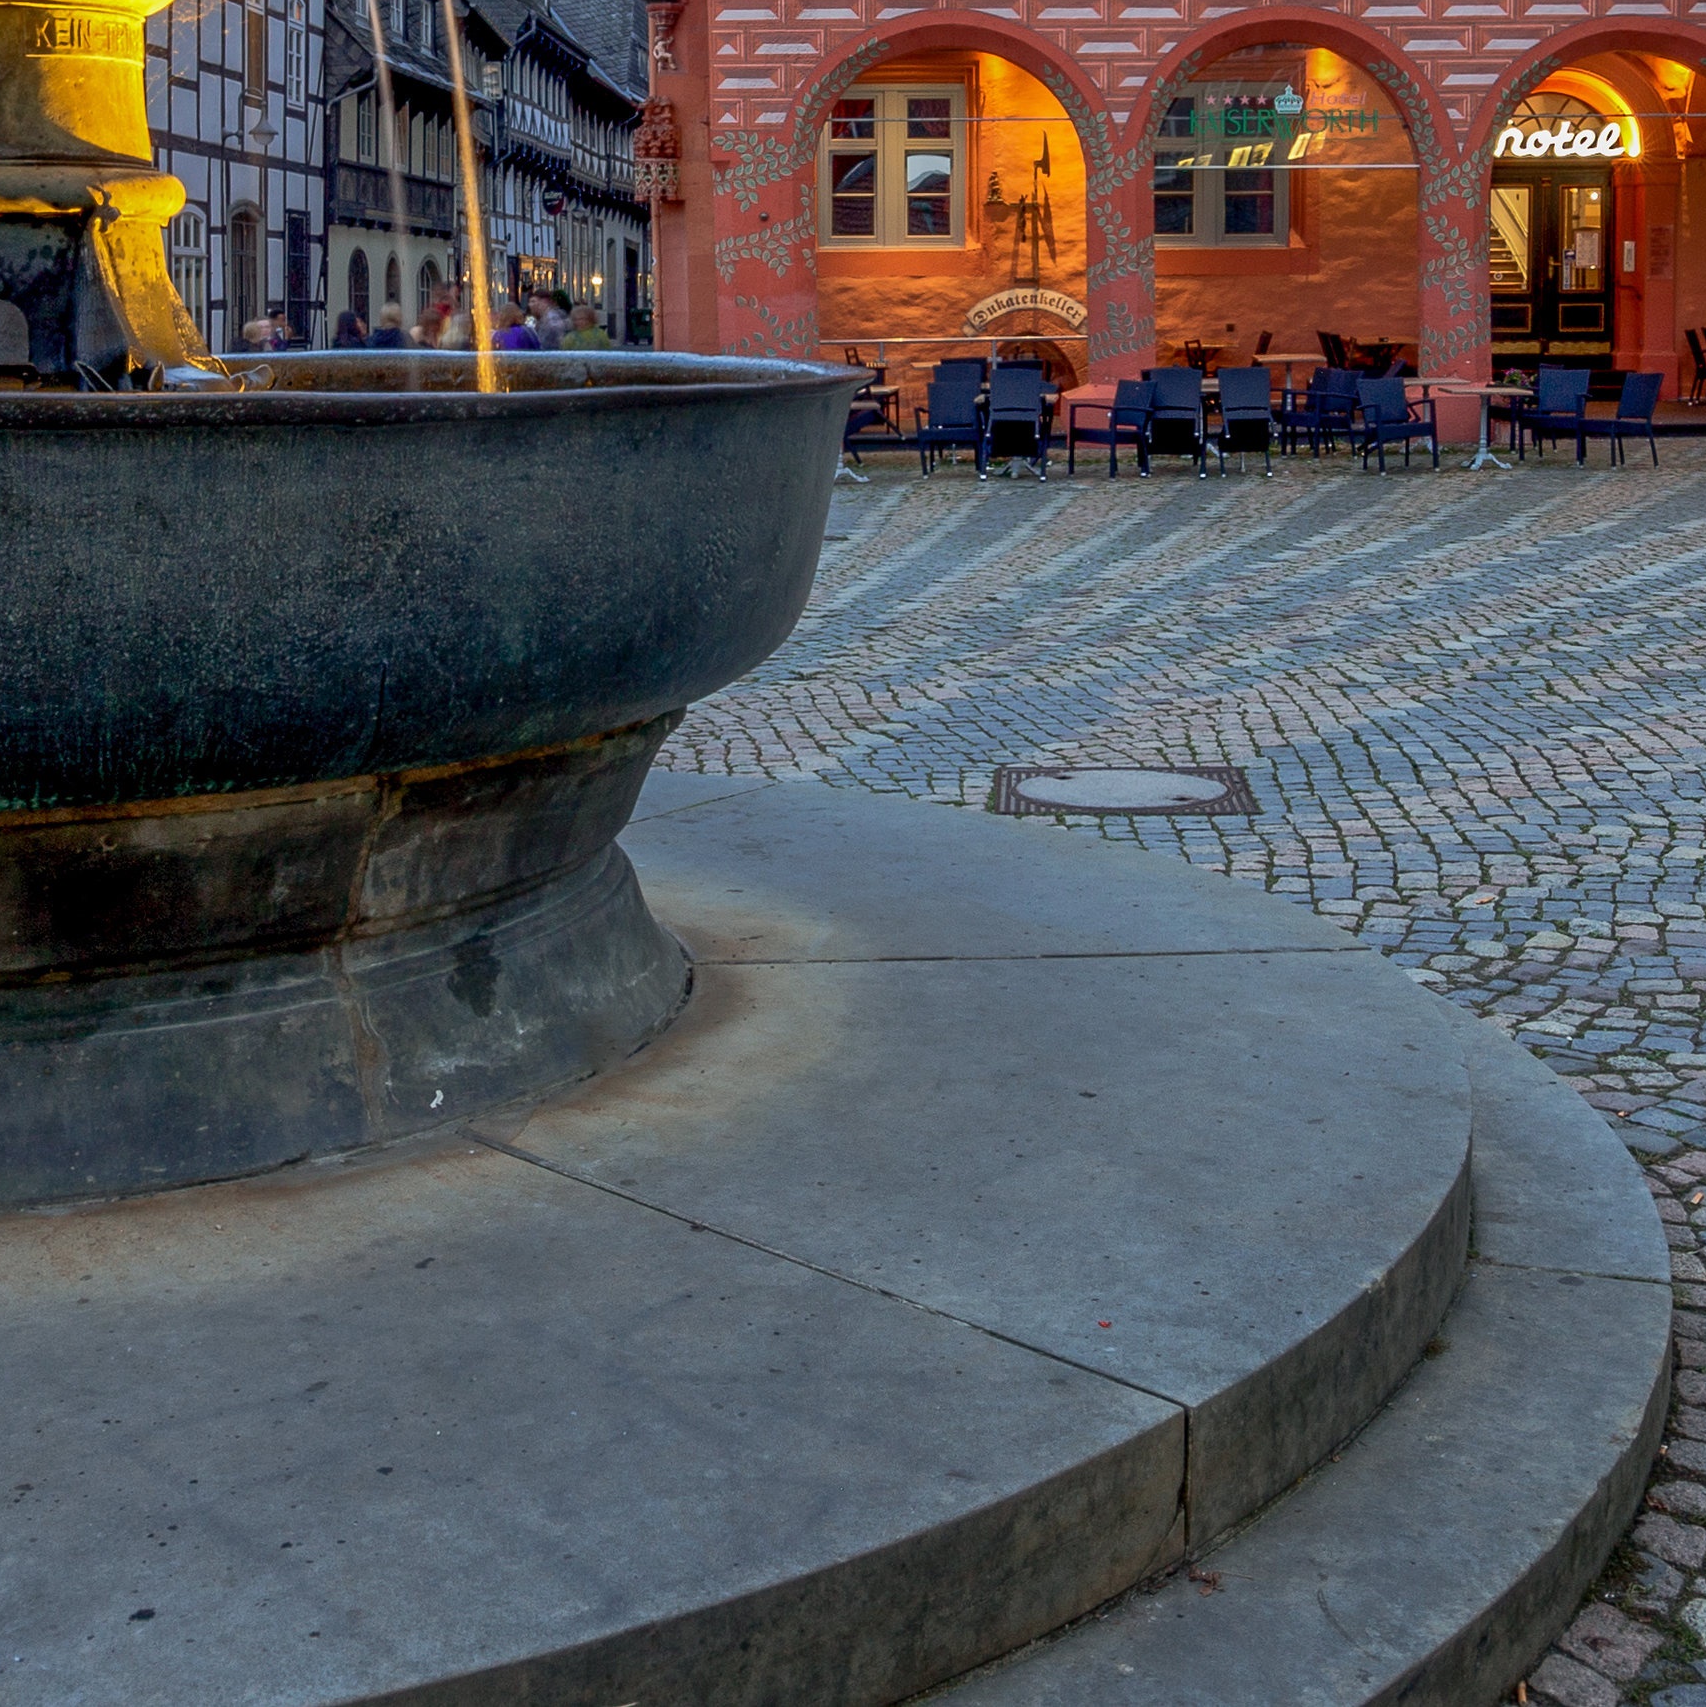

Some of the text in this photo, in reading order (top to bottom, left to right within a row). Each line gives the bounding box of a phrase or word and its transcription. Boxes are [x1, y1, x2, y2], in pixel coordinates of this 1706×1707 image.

[1310, 90, 1367, 106] Hotel
[1188, 107, 1379, 141] KAISERWORTH
[972, 291, 1082, 325] Dukatenkeller
